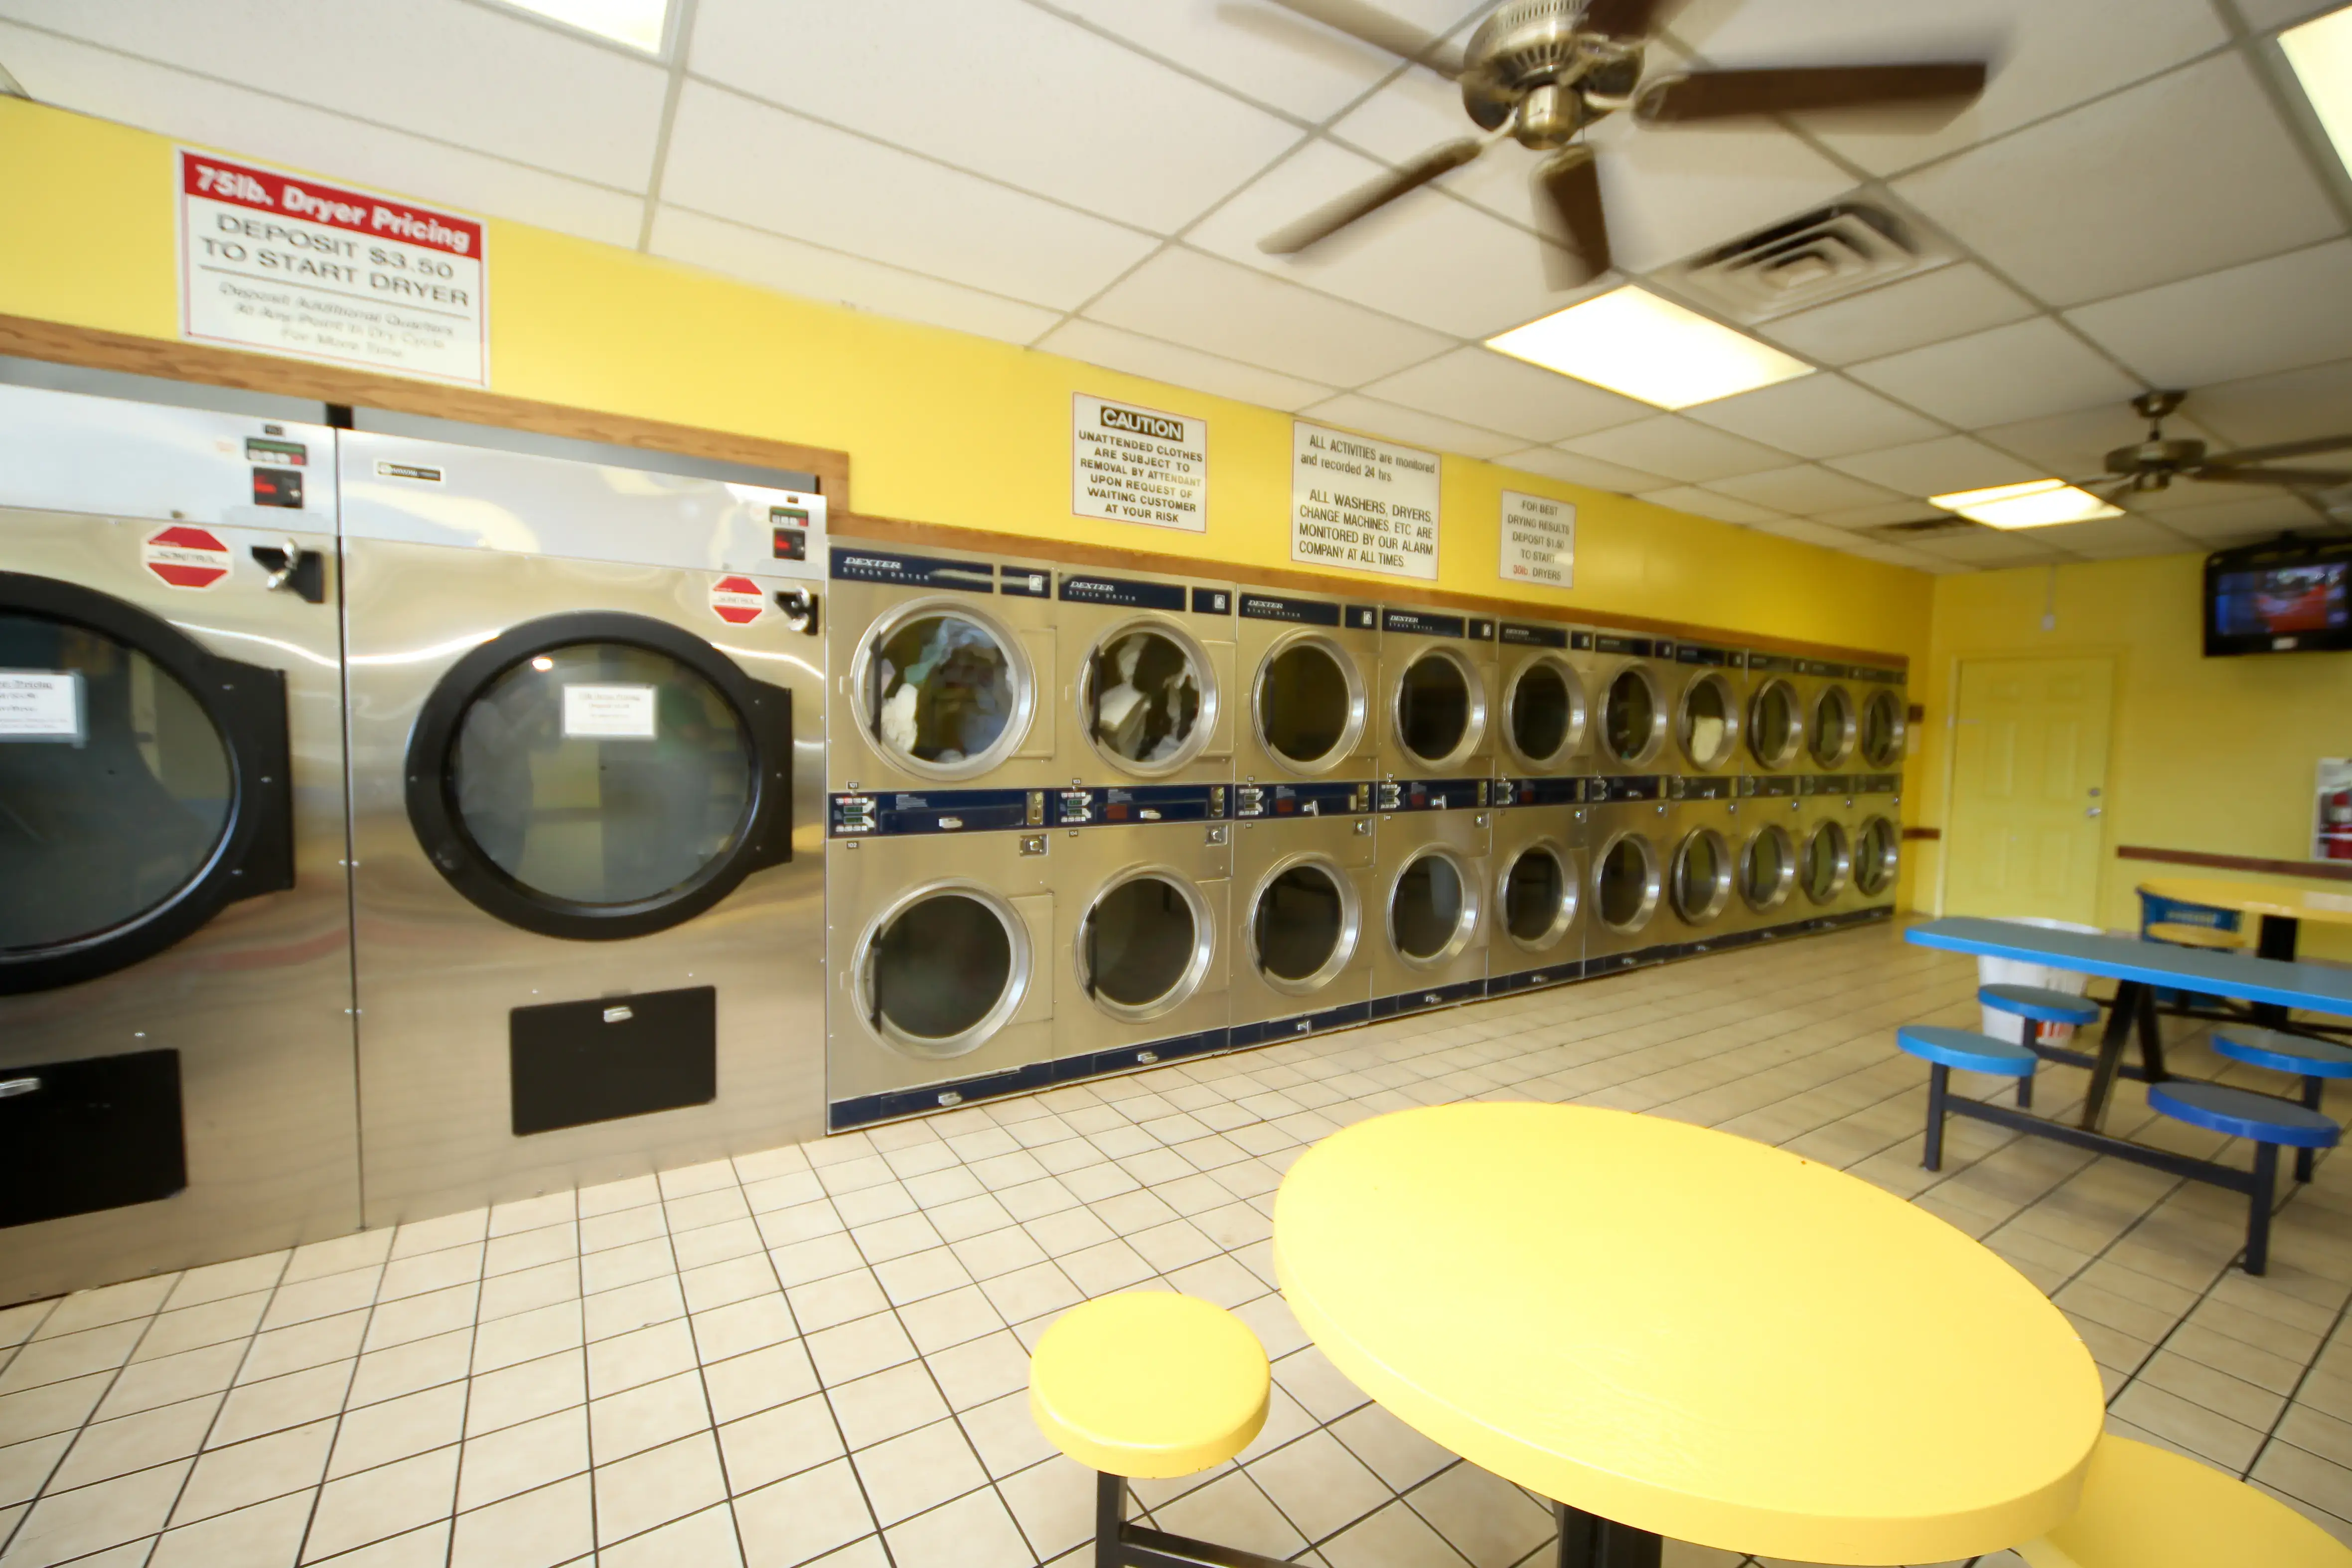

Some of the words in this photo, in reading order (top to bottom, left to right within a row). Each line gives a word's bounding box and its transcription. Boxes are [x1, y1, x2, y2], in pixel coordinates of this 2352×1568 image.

[196, 164, 274, 206] 75lb.
[282, 184, 367, 226] Dryer
[371, 205, 470, 253] Pricing
[217, 213, 358, 257] DEPOSIT
[369, 246, 454, 280] $3.50
[200, 236, 246, 262] TO
[258, 247, 357, 284] START
[370, 271, 470, 307] DRYER
[1103, 408, 1182, 439] CAUTION
[1079, 429, 1153, 452] UNATTENDED
[1157, 445, 1203, 462] CLOTHES
[1310, 434, 1326, 449] ALL
[1330, 439, 1376, 460] ACTIVITIES
[1379, 454, 1392, 464] are
[1396, 456, 1435, 473] monitored
[1094, 447, 1117, 459] ARE
[1122, 452, 1170, 468] SUBJECT
[1176, 462, 1190, 472] TO
[1301, 453, 1317, 466] and
[1322, 458, 1361, 475] recorded
[1365, 466, 1375, 478] 24
[1081, 458, 1127, 474] REMOVAL
[1132, 467, 1144, 477] BY
[1148, 470, 1201, 487] ATTENDANT
[1091, 473, 1122, 486] UPON
[1126, 480, 1176, 496] REQUEST
[1180, 489, 1193, 498] OF
[1087, 487, 1136, 502] WAITING
[1140, 495, 1196, 512] CUSTOMER
[1310, 489, 1329, 504] ALL
[1334, 493, 1388, 517] WASHERS,
[1392, 504, 1433, 525] DRYERS,
[1521, 500, 1537, 512] FOR
[1540, 504, 1558, 516] BEST
[1105, 504, 1118, 513] AT
[1123, 506, 1151, 518] YOUR
[1156, 511, 1179, 522] RISK
[1300, 505, 1339, 522] CHANGE
[1417, 527, 1433, 539] ARE
[1508, 514, 1536, 528] DRYING
[1539, 520, 1570, 535] RESULTS
[1300, 523, 1358, 543] MONITORED
[1363, 533, 1374, 546] BY
[1378, 536, 1398, 550] OUR
[1402, 541, 1433, 556] ALARM
[1513, 531, 1544, 546] DEPOSIT
[844, 557, 901, 569] DEXTER
[1300, 541, 1344, 558] COMPANY
[1347, 549, 1358, 561] AT
[1361, 550, 1376, 563] ALL
[1521, 549, 1531, 560] TO
[1533, 551, 1555, 563] START
[843, 567, 882, 576] STACK
[1533, 568, 1561, 581] DRYERS
[1070, 581, 1114, 591] DEXTER
[1248, 600, 1283, 609] DEXTER
